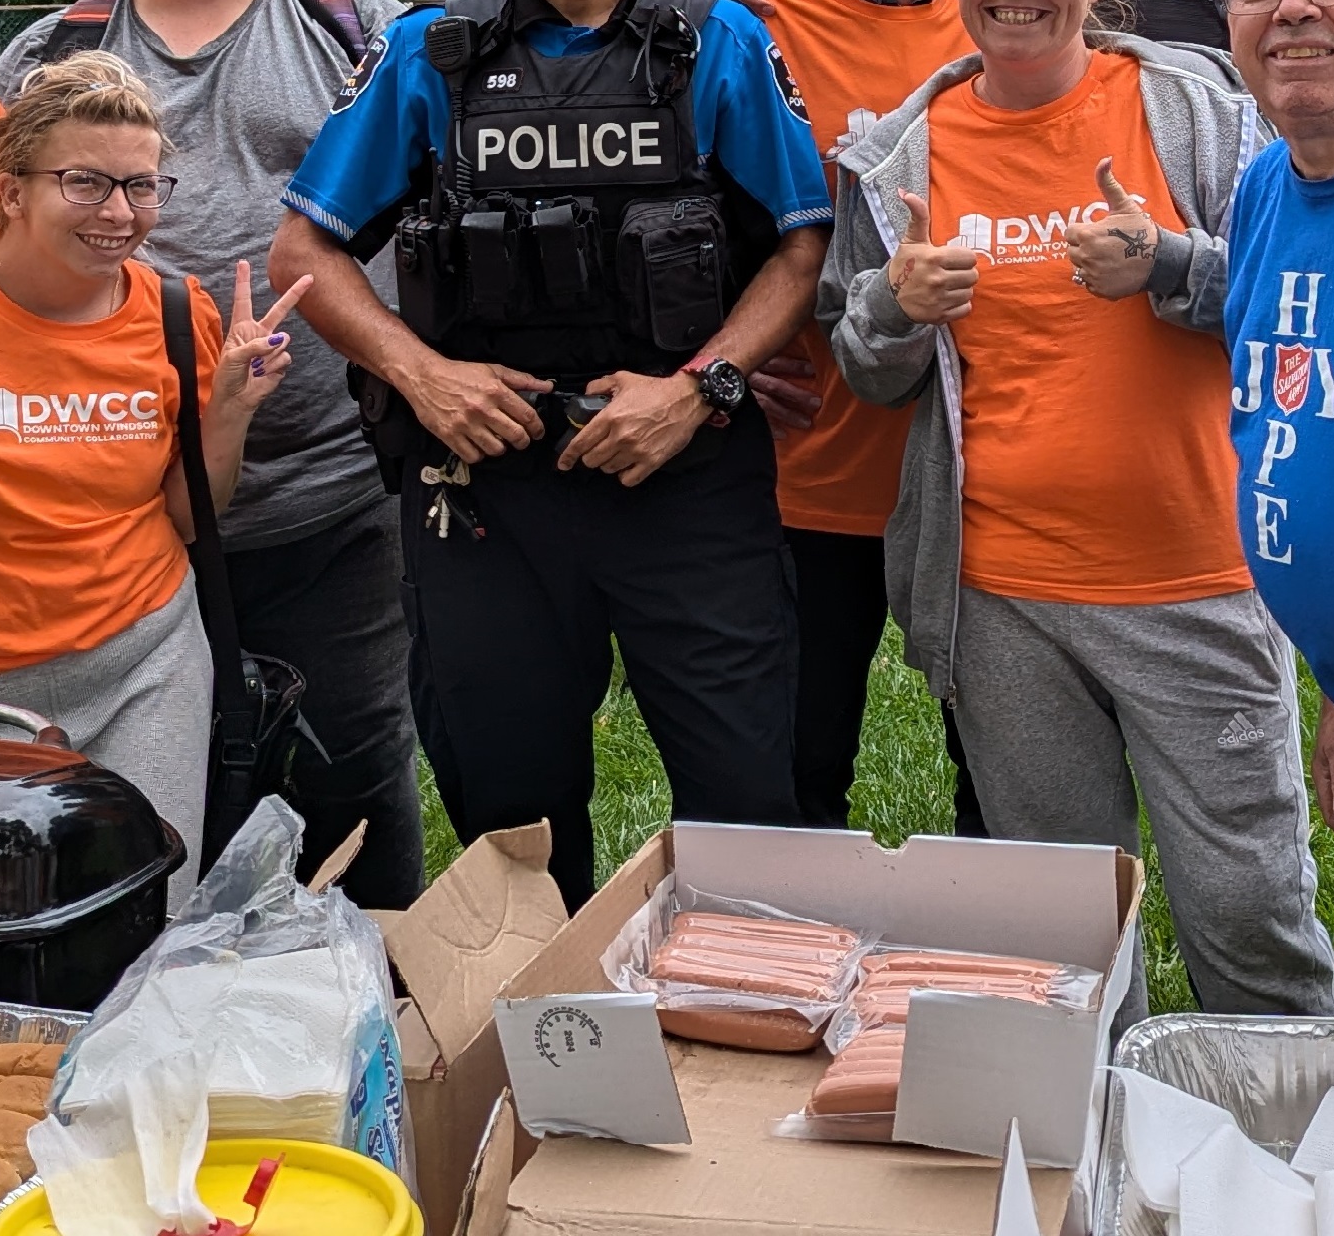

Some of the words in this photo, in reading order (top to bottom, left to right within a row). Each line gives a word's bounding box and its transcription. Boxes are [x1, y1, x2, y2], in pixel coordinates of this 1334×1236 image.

[486, 73, 517, 89] 598
[478, 121, 662, 172] POLICE
[996, 251, 1067, 265] COMMUNTY
[1284, 352, 1302, 374] THE
[1285, 376, 1307, 406] ARMY
[21, 390, 159, 423] DWCC
[23, 424, 100, 434] DOWNTOWN
[103, 421, 159, 431] WINDSOR
[23, 435, 82, 444] COMMUNITY
[85, 432, 158, 442] COLLABORATIVE
[1217, 728, 1265, 744] adidas
